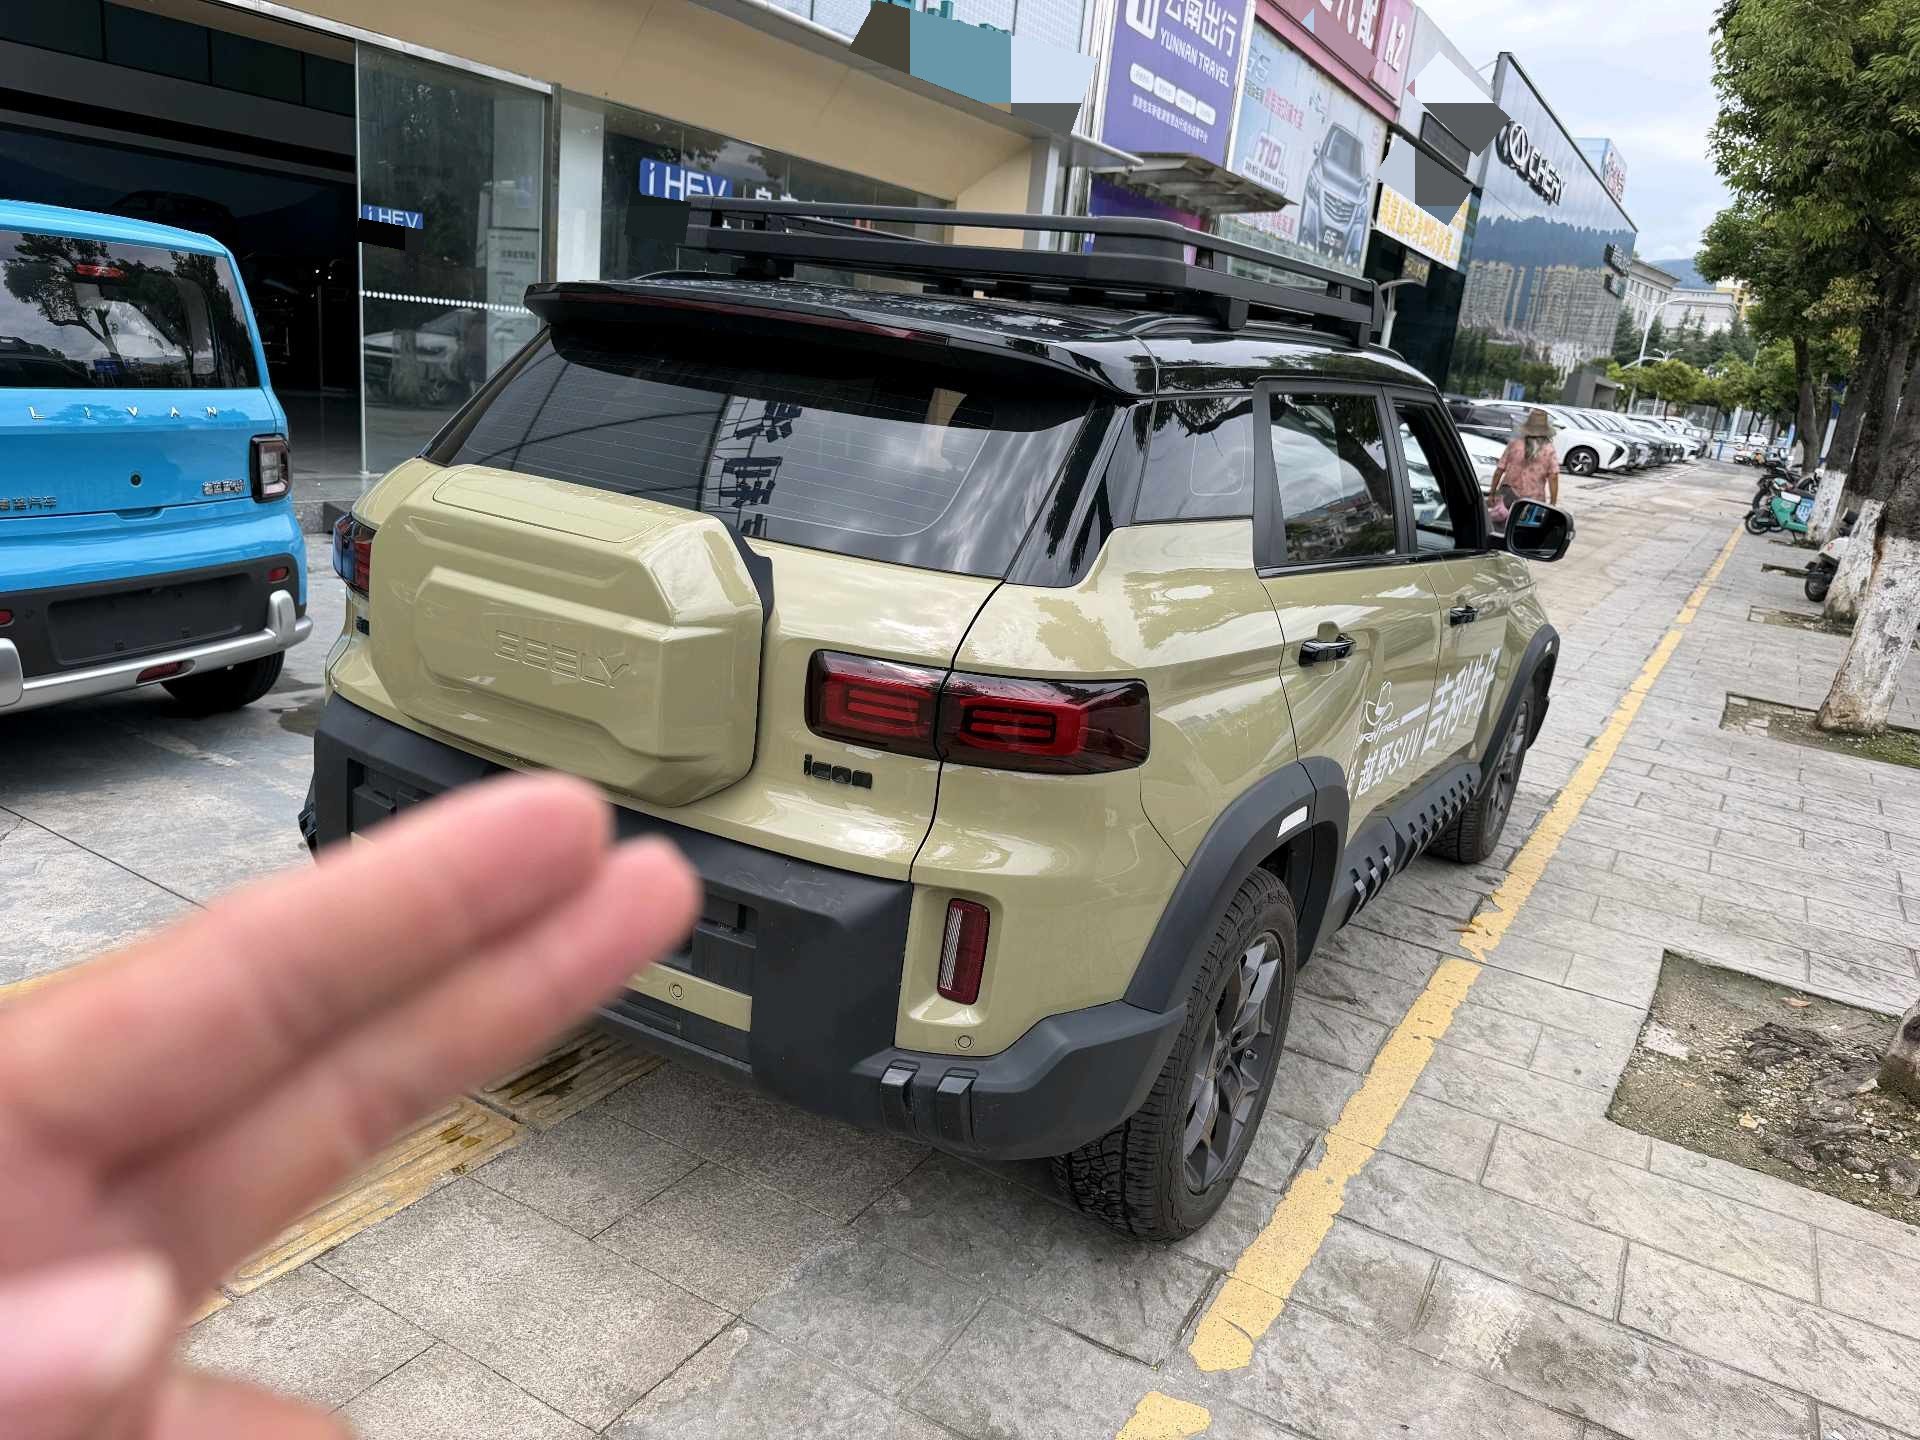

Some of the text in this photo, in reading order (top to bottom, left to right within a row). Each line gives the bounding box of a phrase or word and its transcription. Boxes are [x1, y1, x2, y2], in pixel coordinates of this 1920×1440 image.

[1160, 27, 1198, 67] YUNNAN
[1198, 51, 1230, 88] TRAVEL
[28, 405, 218, 420] LIVAN
[494, 629, 631, 689] GEELY
